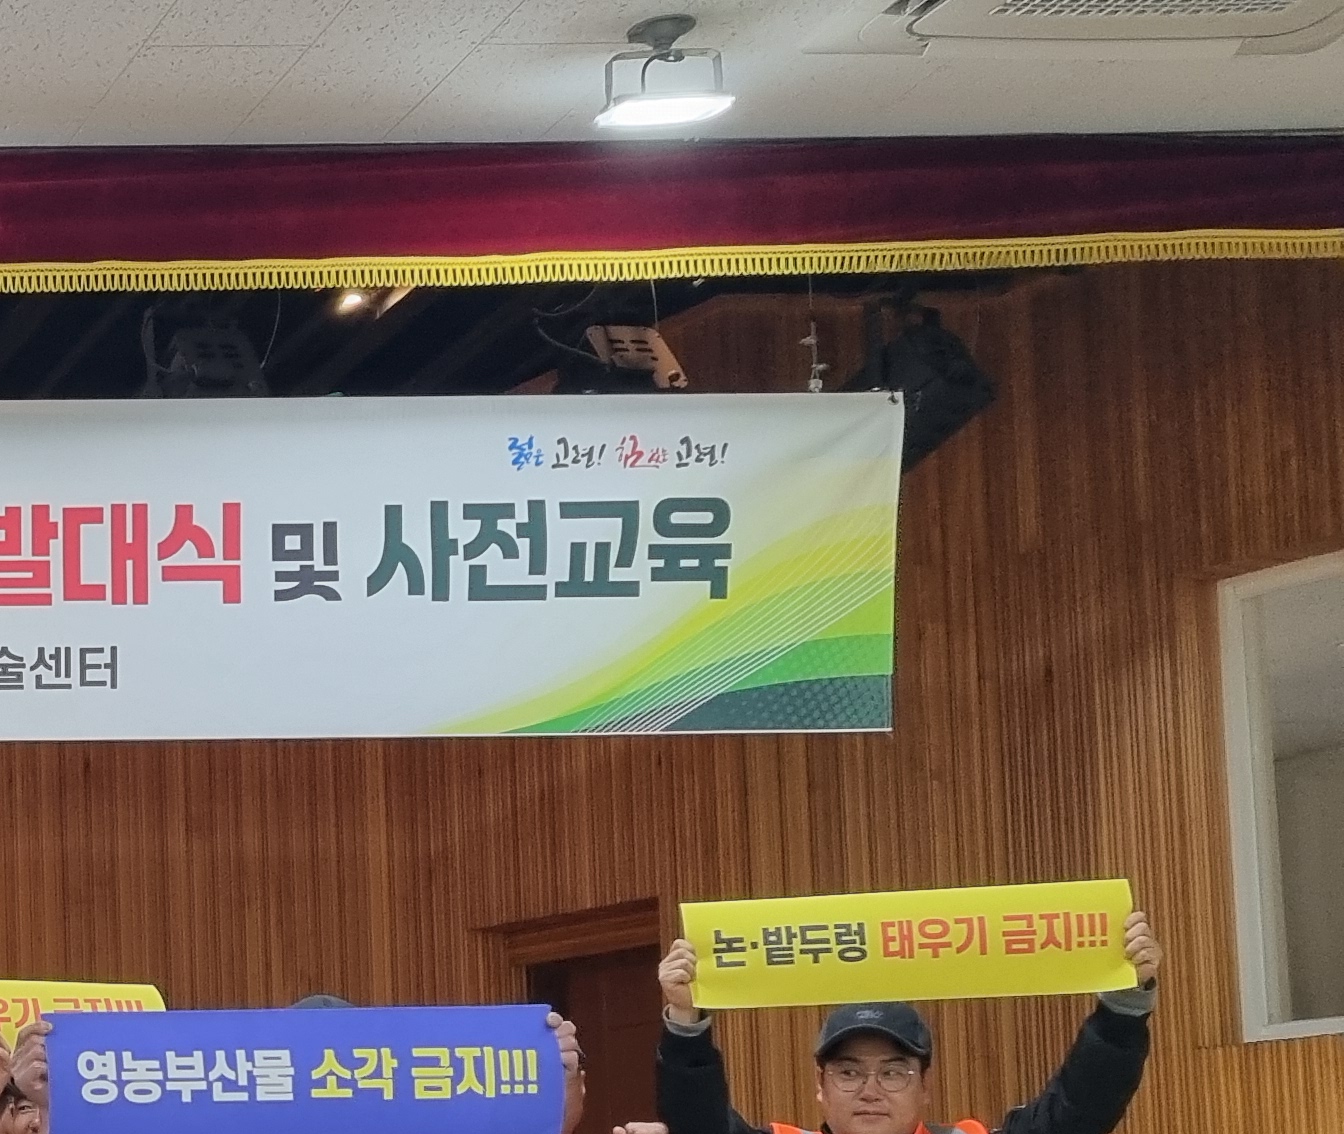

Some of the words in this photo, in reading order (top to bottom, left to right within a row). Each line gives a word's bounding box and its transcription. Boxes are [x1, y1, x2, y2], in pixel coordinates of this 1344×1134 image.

[552, 437, 606, 469] 고령!
[676, 436, 728, 468] 고령!
[272, 522, 342, 601] 및
[367, 498, 734, 601] 사전교육
[713, 923, 867, 968] 논·밭두렁
[881, 916, 987, 959] 태우기
[1002, 912, 1108, 954] 금지!!!
[77, 1049, 295, 1104] 영농부산물
[311, 1048, 398, 1100] 소각
[412, 1046, 538, 1099] 금지!!!
